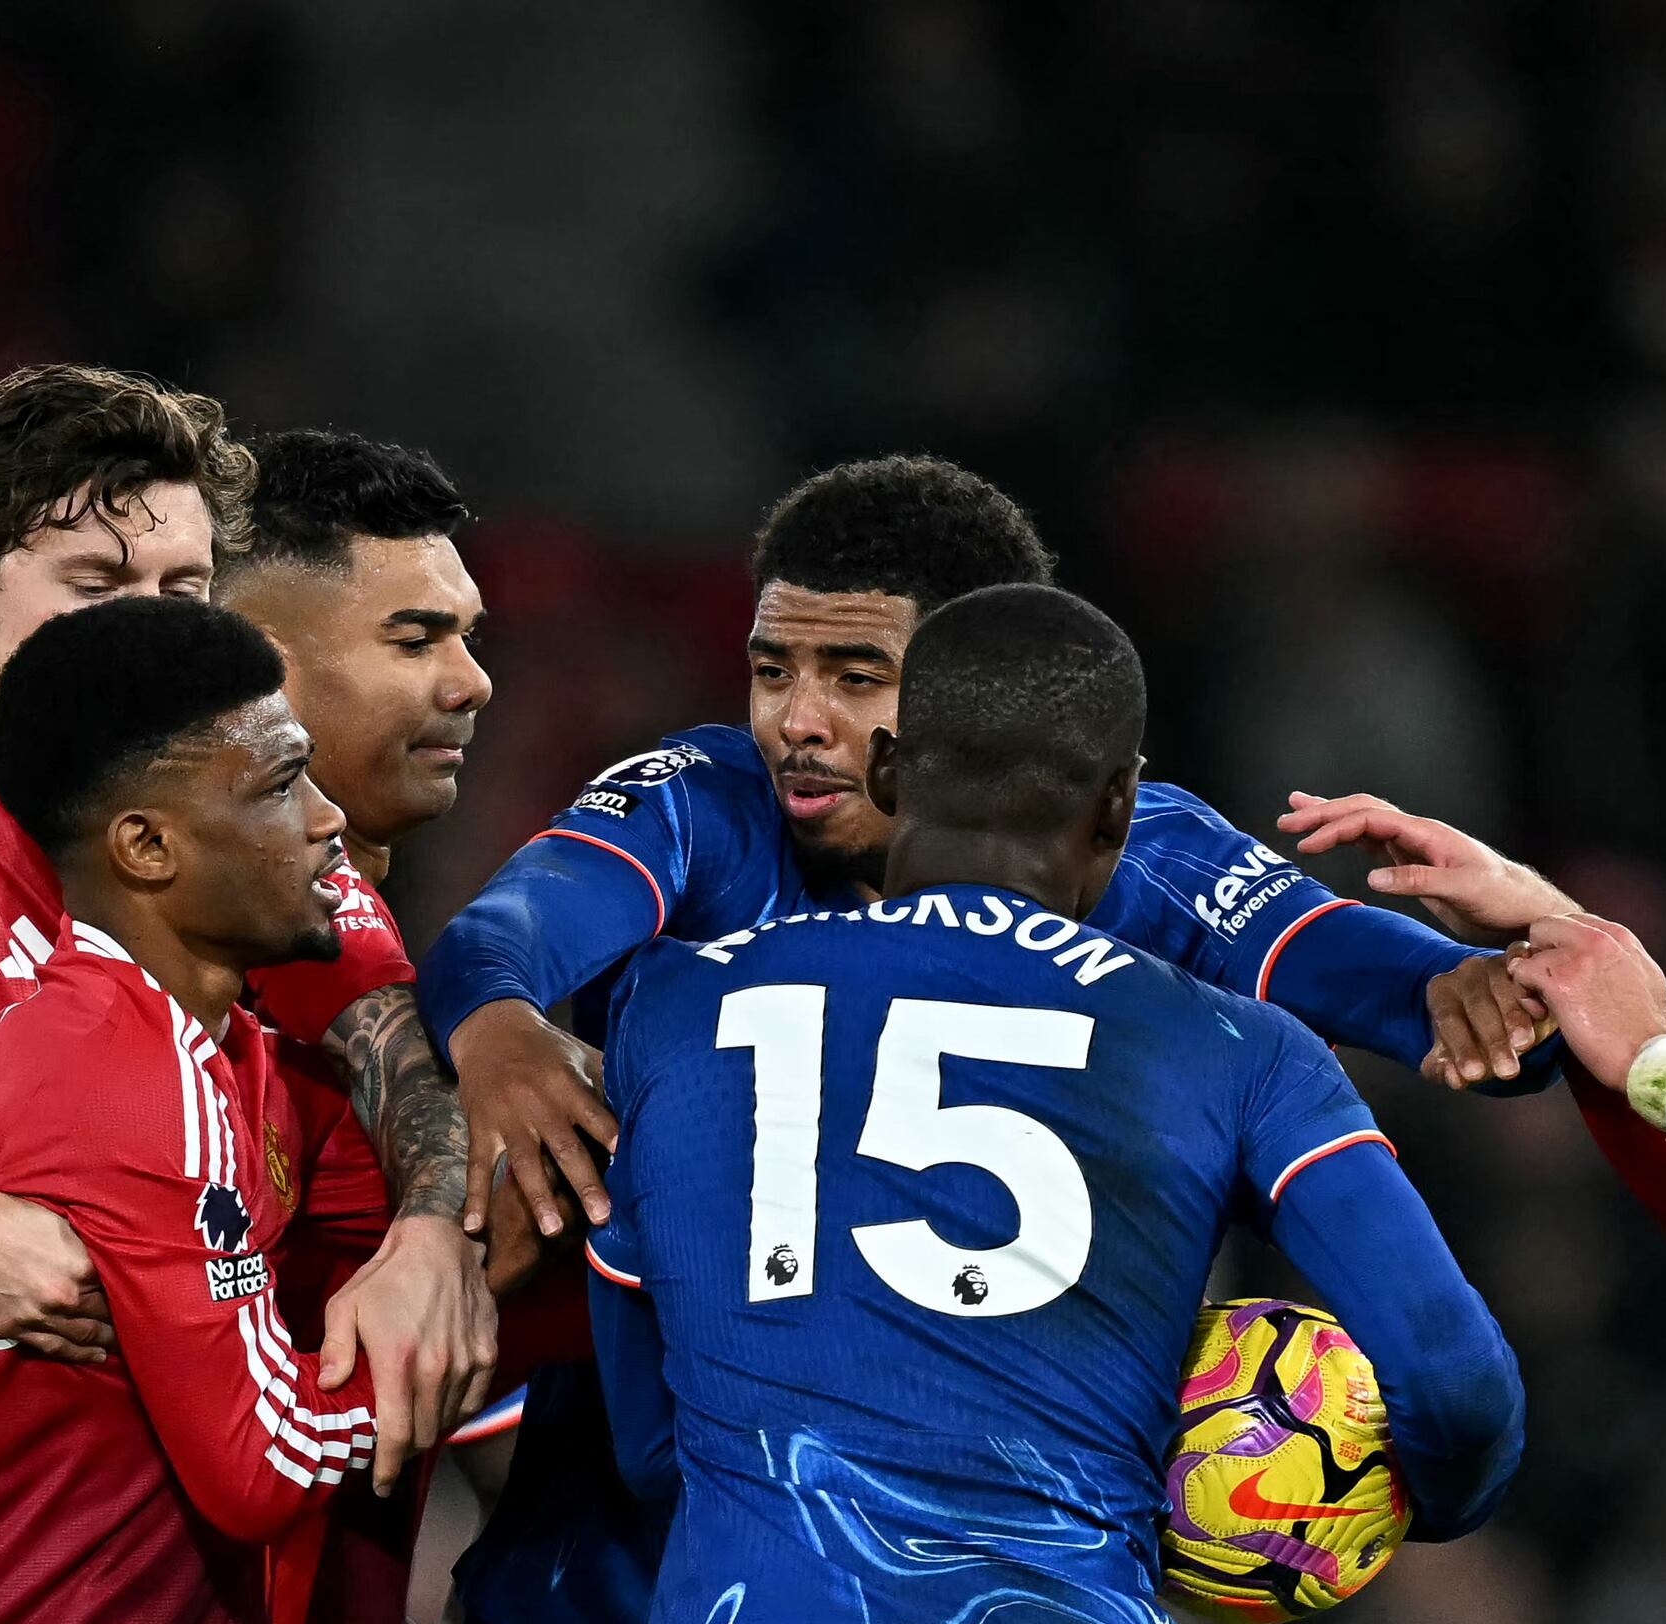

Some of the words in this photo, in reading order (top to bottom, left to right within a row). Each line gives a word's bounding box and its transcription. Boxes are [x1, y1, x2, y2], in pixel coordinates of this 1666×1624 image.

[1195, 845, 1292, 928] feve
[715, 984, 1095, 1317] 15
[205, 1258, 234, 1280] No
[237, 1253, 265, 1277] roo
